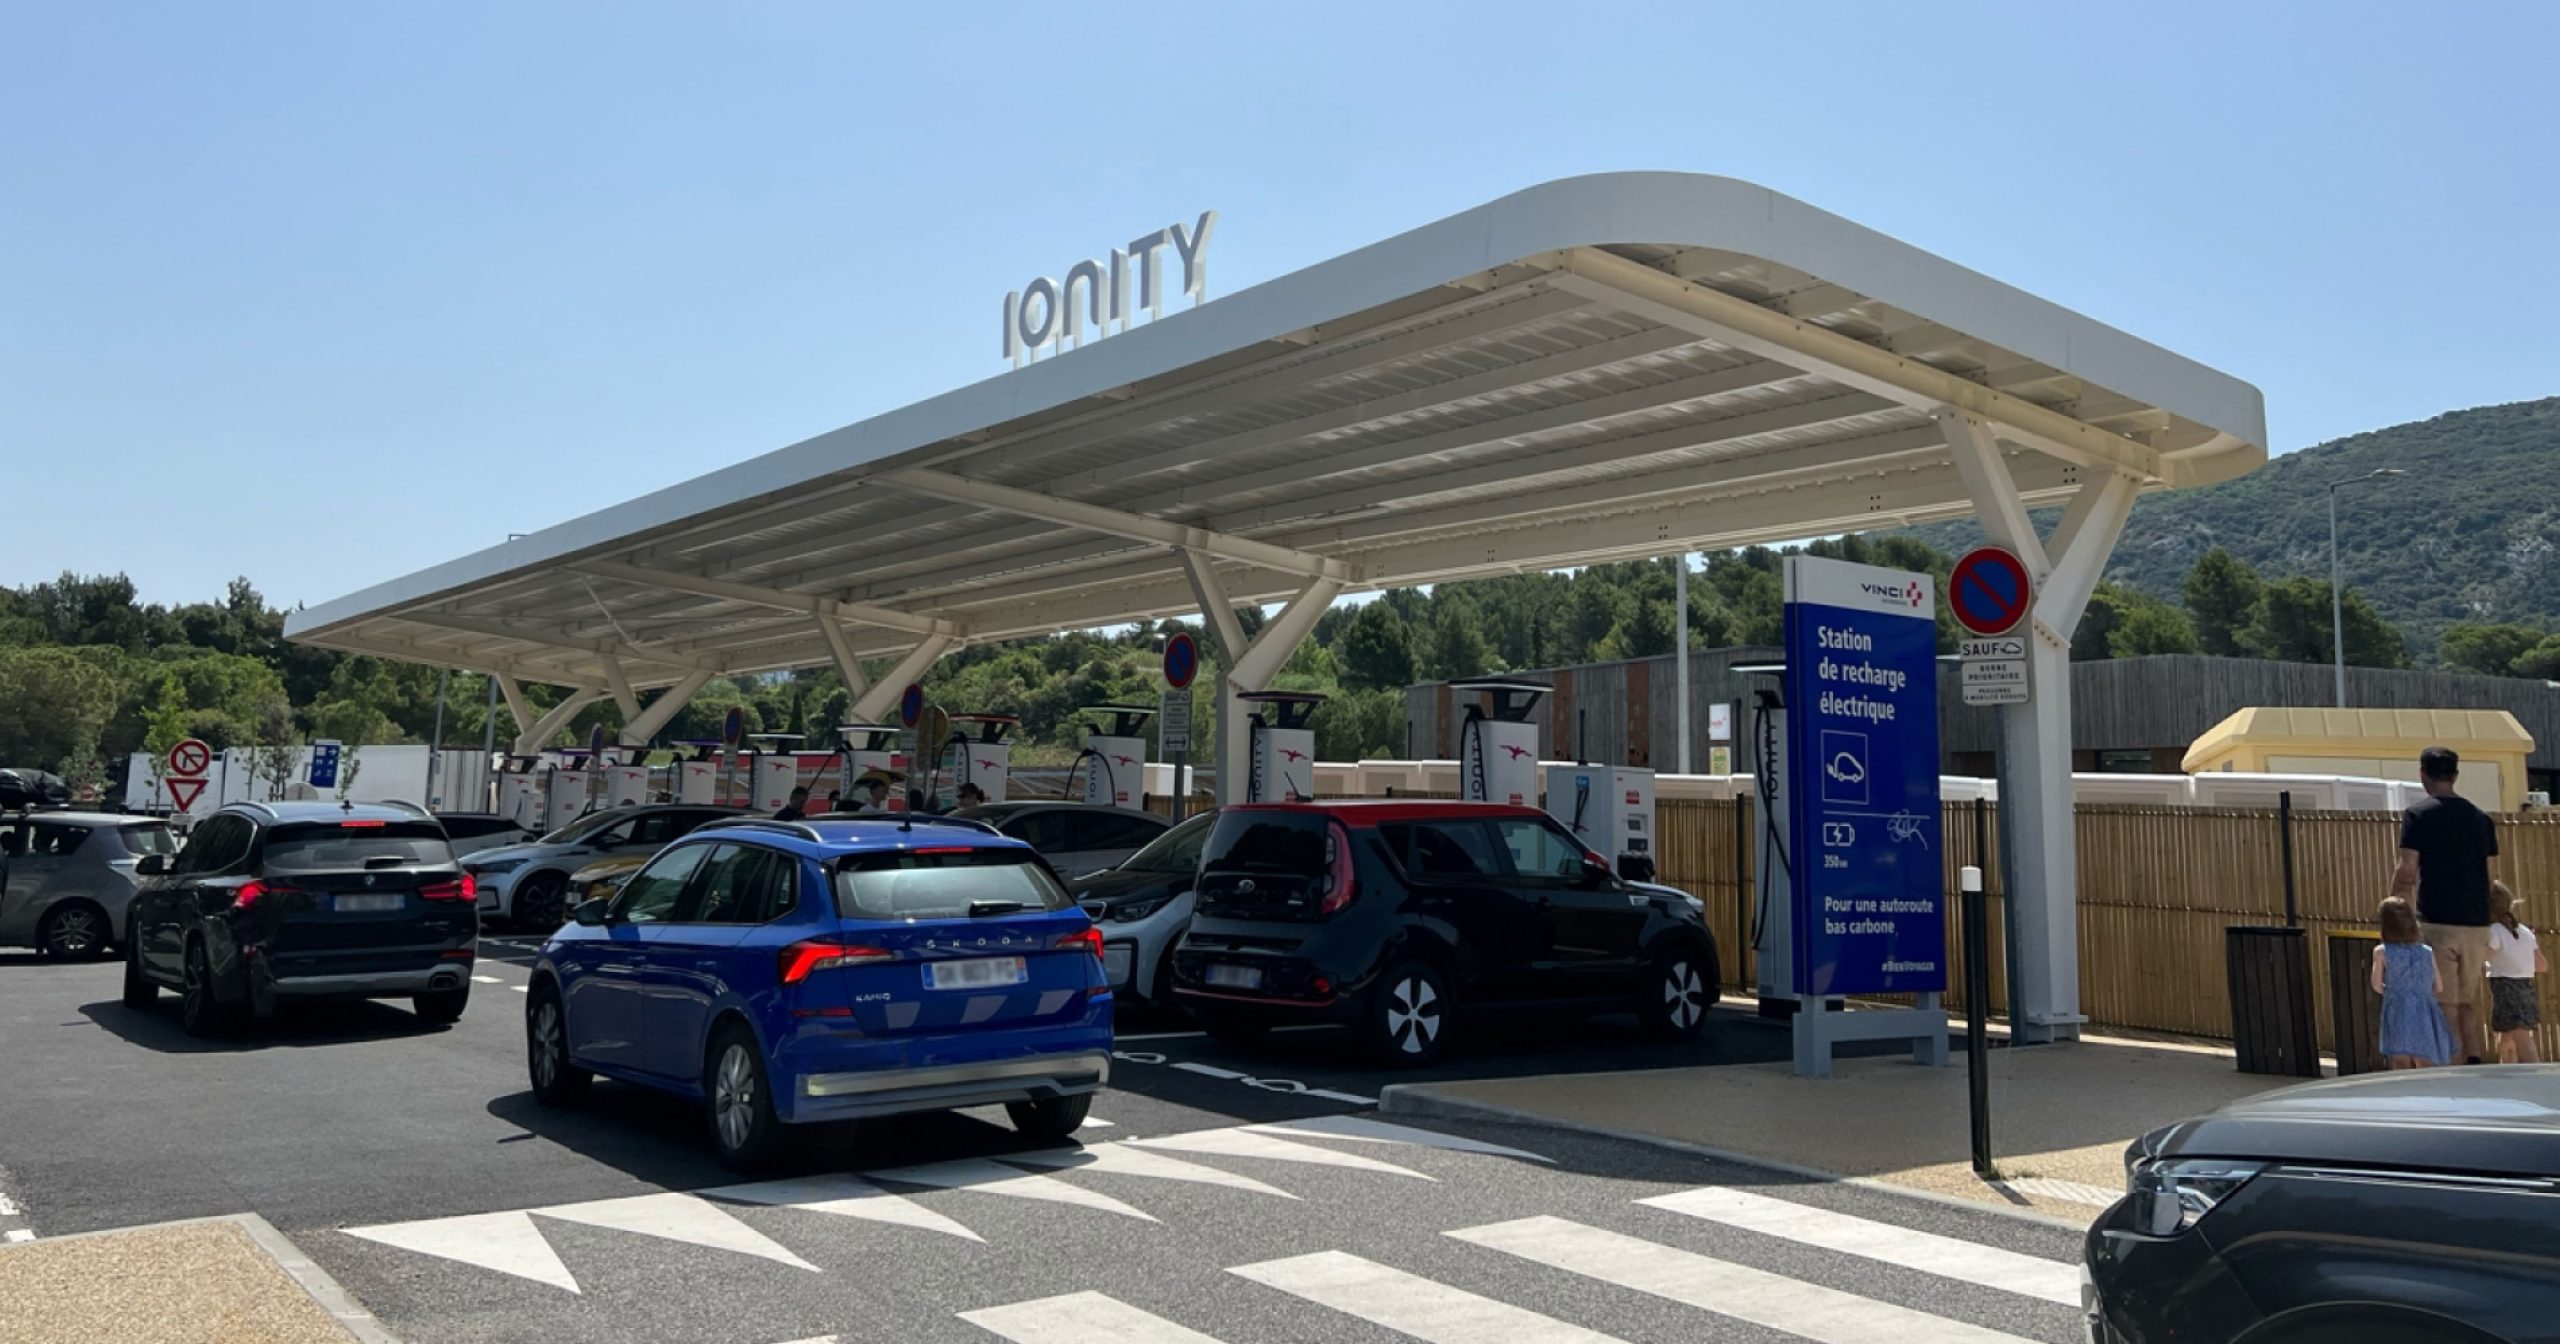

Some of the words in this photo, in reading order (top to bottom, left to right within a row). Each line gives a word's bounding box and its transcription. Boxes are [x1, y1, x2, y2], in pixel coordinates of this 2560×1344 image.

[1003, 210, 1218, 360] IONITY
[1861, 583, 1903, 598] VINCI
[1818, 626, 1872, 651] Station
[1962, 643, 2000, 656] SAUF
[1818, 656, 1838, 680] de
[1842, 661, 1906, 692] recharge
[1820, 691, 1895, 725] électrique
[1824, 896, 1852, 912] Pour
[1855, 900, 1877, 912] une
[1880, 898, 1934, 913] autoroute
[1825, 917, 1847, 934] bas
[1849, 918, 1895, 934] carbone
[855, 993, 891, 1003] KAMIQ
